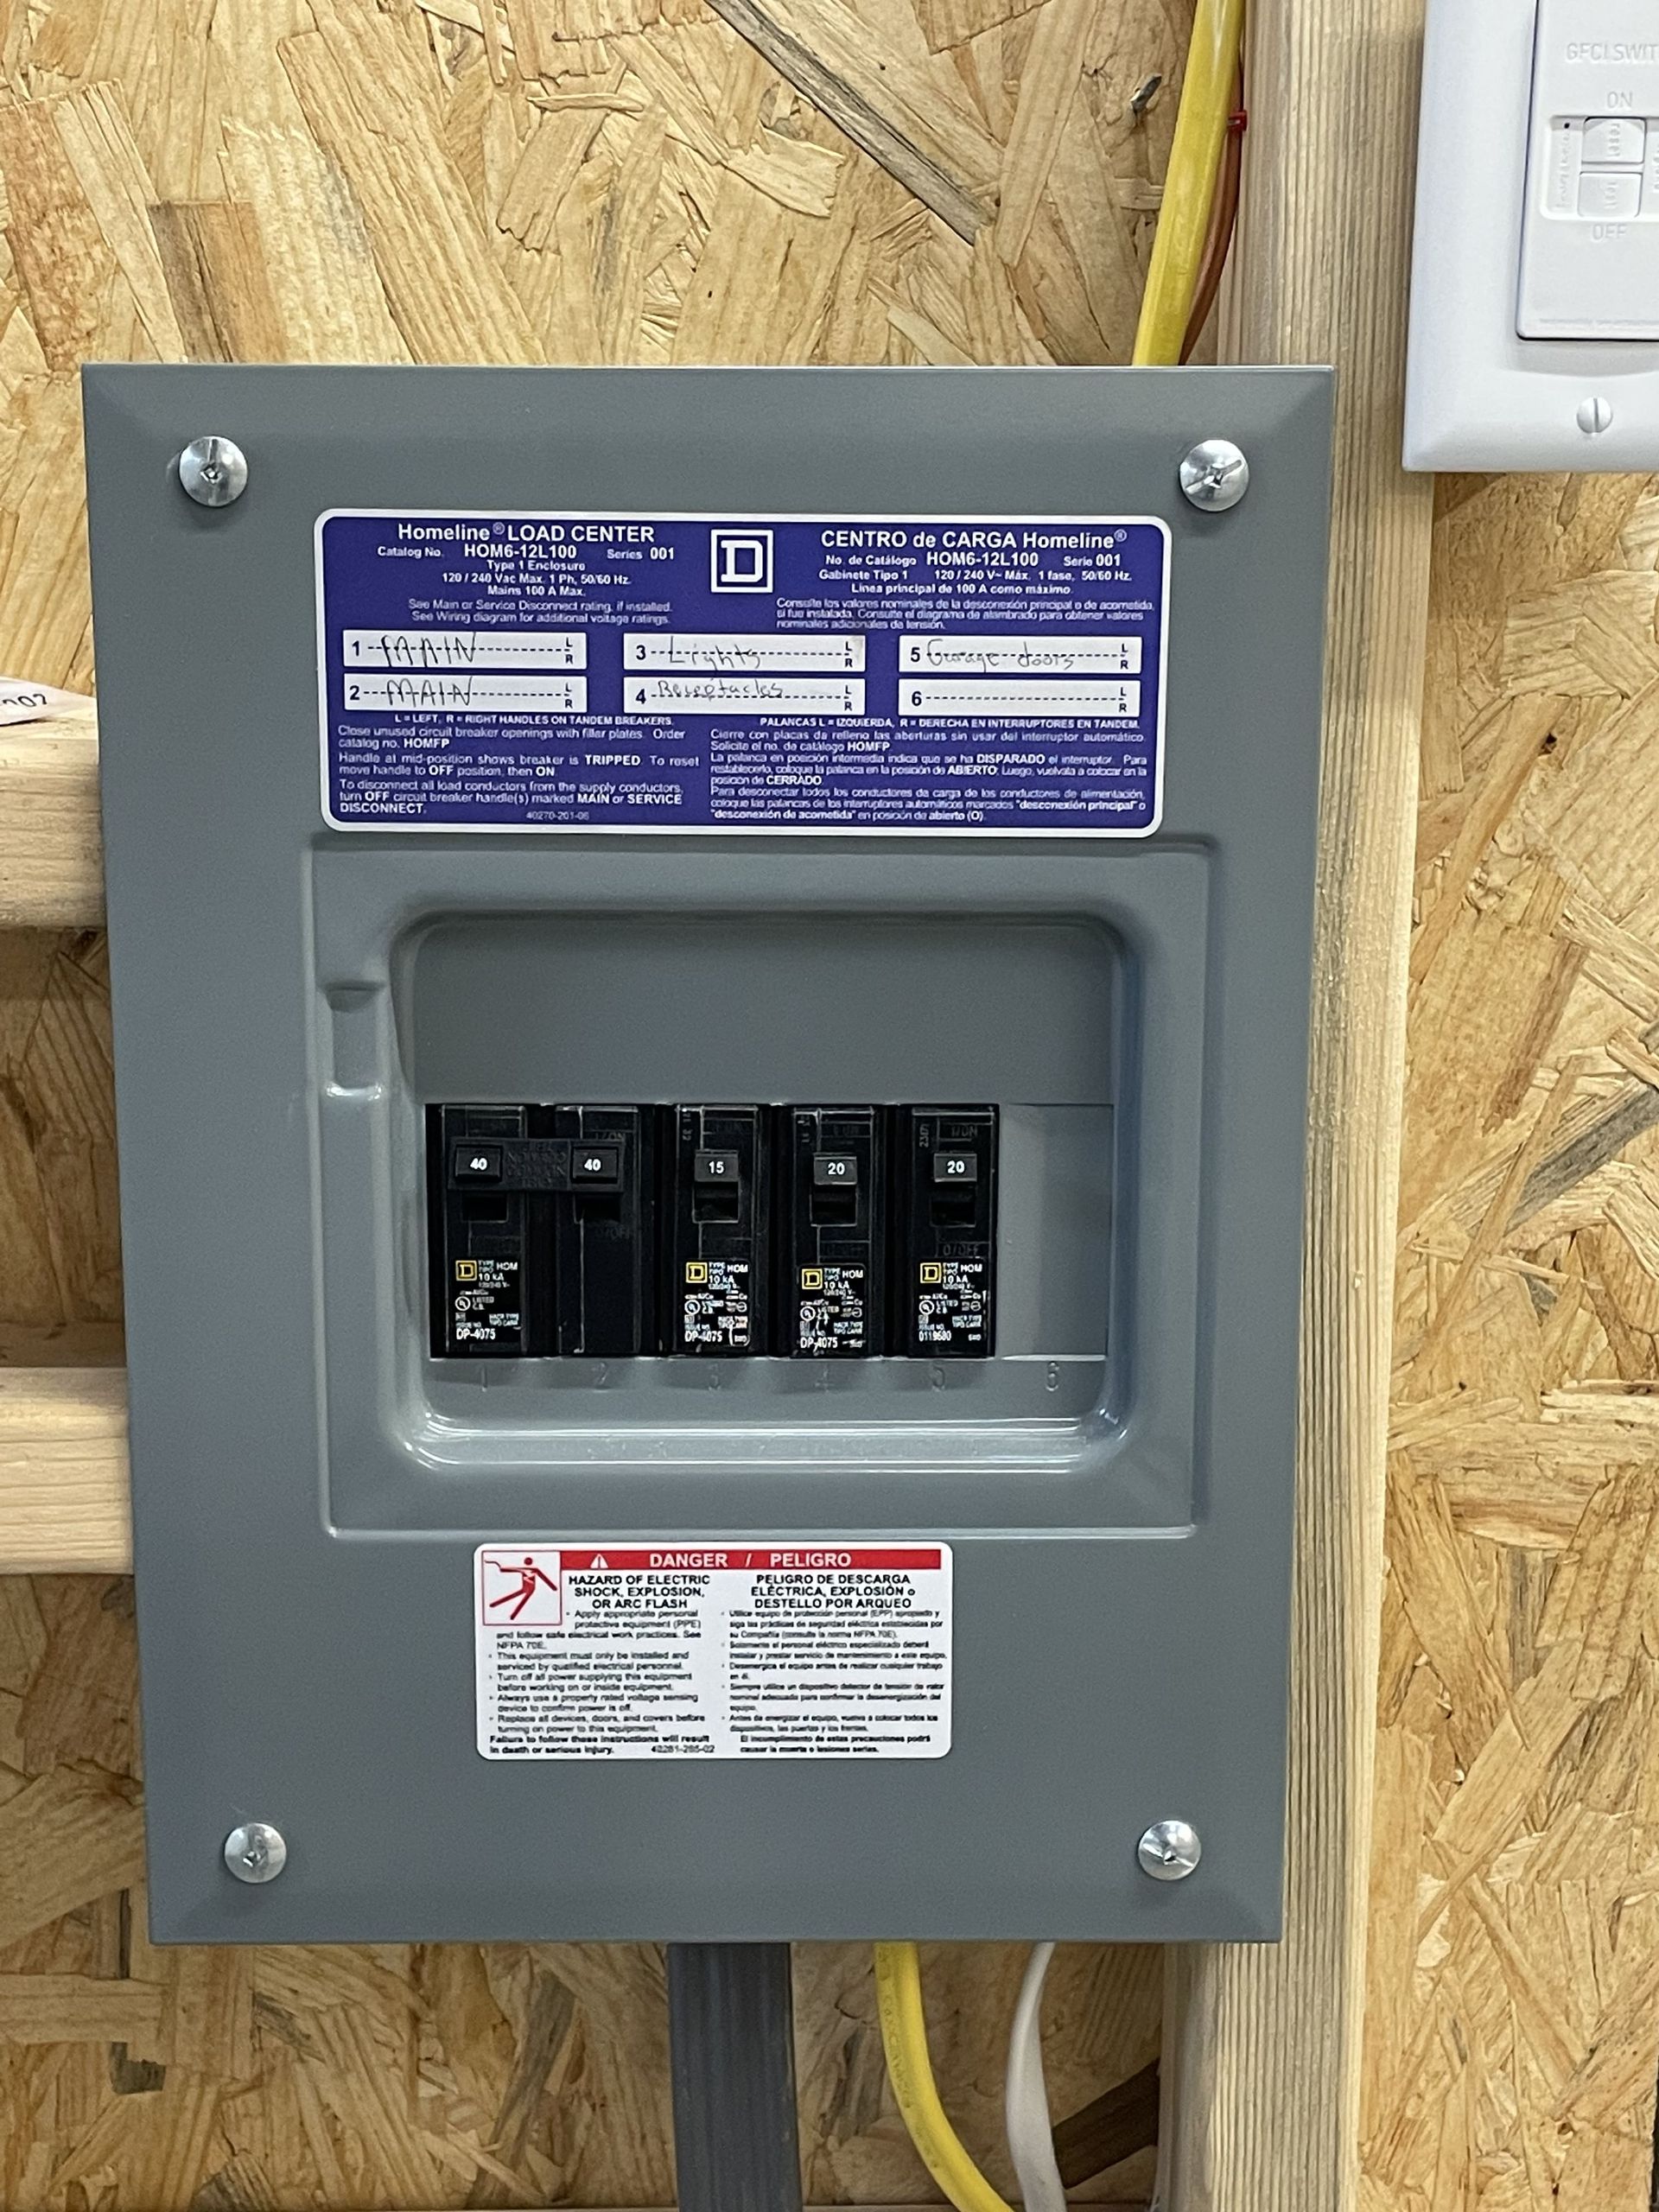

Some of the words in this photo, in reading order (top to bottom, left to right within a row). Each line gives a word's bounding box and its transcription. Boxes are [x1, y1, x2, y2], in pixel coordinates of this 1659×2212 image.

[1606, 90, 1634, 109] ON
[1592, 224, 1627, 241] OFF
[507, 524, 564, 543] LOAD
[570, 525, 654, 543] CENTER
[821, 530, 907, 547] CENTRO
[912, 531, 937, 548] de
[942, 531, 1016, 548] CARGA
[377, 546, 422, 558] Catalog
[464, 544, 577, 558] HOM6-12L100
[607, 549, 643, 559] Series
[650, 547, 674, 559] 001
[849, 555, 862, 564] de
[866, 555, 916, 567] Catálogo
[926, 552, 1039, 566] HOM6-12L100
[1063, 556, 1092, 566] Serie
[1096, 554, 1120, 566] 001
[487, 560, 515, 572] Type
[518, 560, 524, 569] 1
[527, 560, 585, 570] Enclosure
[442, 572, 461, 582] 120
[465, 573, 468, 582] /
[472, 573, 492, 584] 240
[494, 573, 515, 584] Vac
[550, 574, 555, 584] 1
[581, 574, 610, 584] 50/60
[819, 569, 869, 580] Gabinete
[873, 569, 899, 582] Tipo
[902, 569, 907, 580] 1
[935, 569, 954, 580] 120
[957, 569, 961, 579] /
[963, 569, 983, 580] 240
[1039, 570, 1044, 580] 1
[1082, 570, 1111, 581] 50/60
[487, 585, 521, 594] Mains
[525, 586, 544, 595] 100
[548, 586, 556, 595] A
[885, 583, 935, 594] principal
[938, 583, 952, 594] de
[957, 583, 975, 594] 100
[978, 584, 987, 593] A
[565, 638, 573, 647] L
[844, 641, 852, 652] L
[352, 641, 360, 657] 1
[381, 632, 476, 667] MAIN
[635, 645, 646, 660] 3
[669, 635, 760, 670] Lights
[911, 646, 921, 663] 5
[565, 655, 574, 664] R
[926, 639, 1000, 673] Garage
[1017, 641, 1074, 671] doors
[844, 658, 854, 668] R
[1120, 660, 1129, 670] R
[349, 685, 360, 701] 2
[387, 677, 473, 707] MAIN
[564, 683, 572, 692] L
[844, 684, 852, 695] L
[635, 689, 646, 704] 4
[911, 690, 922, 707] 6
[564, 699, 573, 709] R
[843, 702, 853, 711] R
[1119, 703, 1128, 713] R
[411, 714, 443, 723] LEFT,
[465, 715, 498, 723] RIGHT
[499, 715, 550, 724] HANDLES
[550, 715, 567, 724] ON
[569, 715, 613, 724] TANDEM
[614, 715, 676, 725] BREAKERS.
[338, 725, 371, 737] Close
[373, 727, 416, 737] unused
[418, 727, 452, 737] circuit
[455, 727, 499, 738] breaker
[501, 728, 553, 741] openings
[556, 728, 580, 738] with
[582, 728, 606, 739] filler
[652, 728, 685, 739] Order
[339, 738, 379, 750] catalog
[404, 738, 449, 748] HOMFP
[340, 791, 362, 801] turn
[364, 791, 389, 803] OFF
[393, 791, 427, 802] circuit
[430, 792, 472, 802] breaker
[475, 792, 529, 804] handle(s)
[531, 793, 574, 804] marked
[577, 791, 609, 804] MAIN
[612, 795, 624, 804] or
[627, 793, 682, 804] SERVICE
[469, 1158, 488, 1171] 40
[584, 1159, 601, 1172] 40
[709, 1161, 724, 1173] 15
[827, 1162, 845, 1175] 20
[947, 1160, 965, 1173] 20
[496, 1262, 518, 1271] HOM
[727, 1264, 748, 1273] HOM
[960, 1263, 983, 1273] HOM
[842, 1269, 864, 1279] HOM
[455, 1328, 496, 1340] DP-4075
[684, 1331, 723, 1343] DP-4075
[800, 1336, 838, 1349] DP-4075
[649, 1553, 728, 1567] DANGER
[770, 1553, 852, 1567] PELIGRO
[569, 1575, 622, 1585] HAZARD
[626, 1574, 643, 1585] OF
[646, 1574, 710, 1585] ELECTRIC
[755, 1574, 814, 1586] PELIGRO
[816, 1574, 835, 1584] DE
[837, 1574, 911, 1586] DESCARGA
[575, 1586, 624, 1599] SHOCK,
[627, 1586, 705, 1599] EXPLOSION,
[750, 1583, 827, 1598] ELÉCTRICA,
[827, 1583, 904, 1596] EXPLOSIÓN
[593, 1599, 610, 1609] OR
[615, 1599, 641, 1608] ARC
[645, 1599, 687, 1608] FLASH
[754, 1599, 821, 1608] DESTELLO
[825, 1598, 852, 1608] POR
[855, 1598, 911, 1608] ARQUEO
